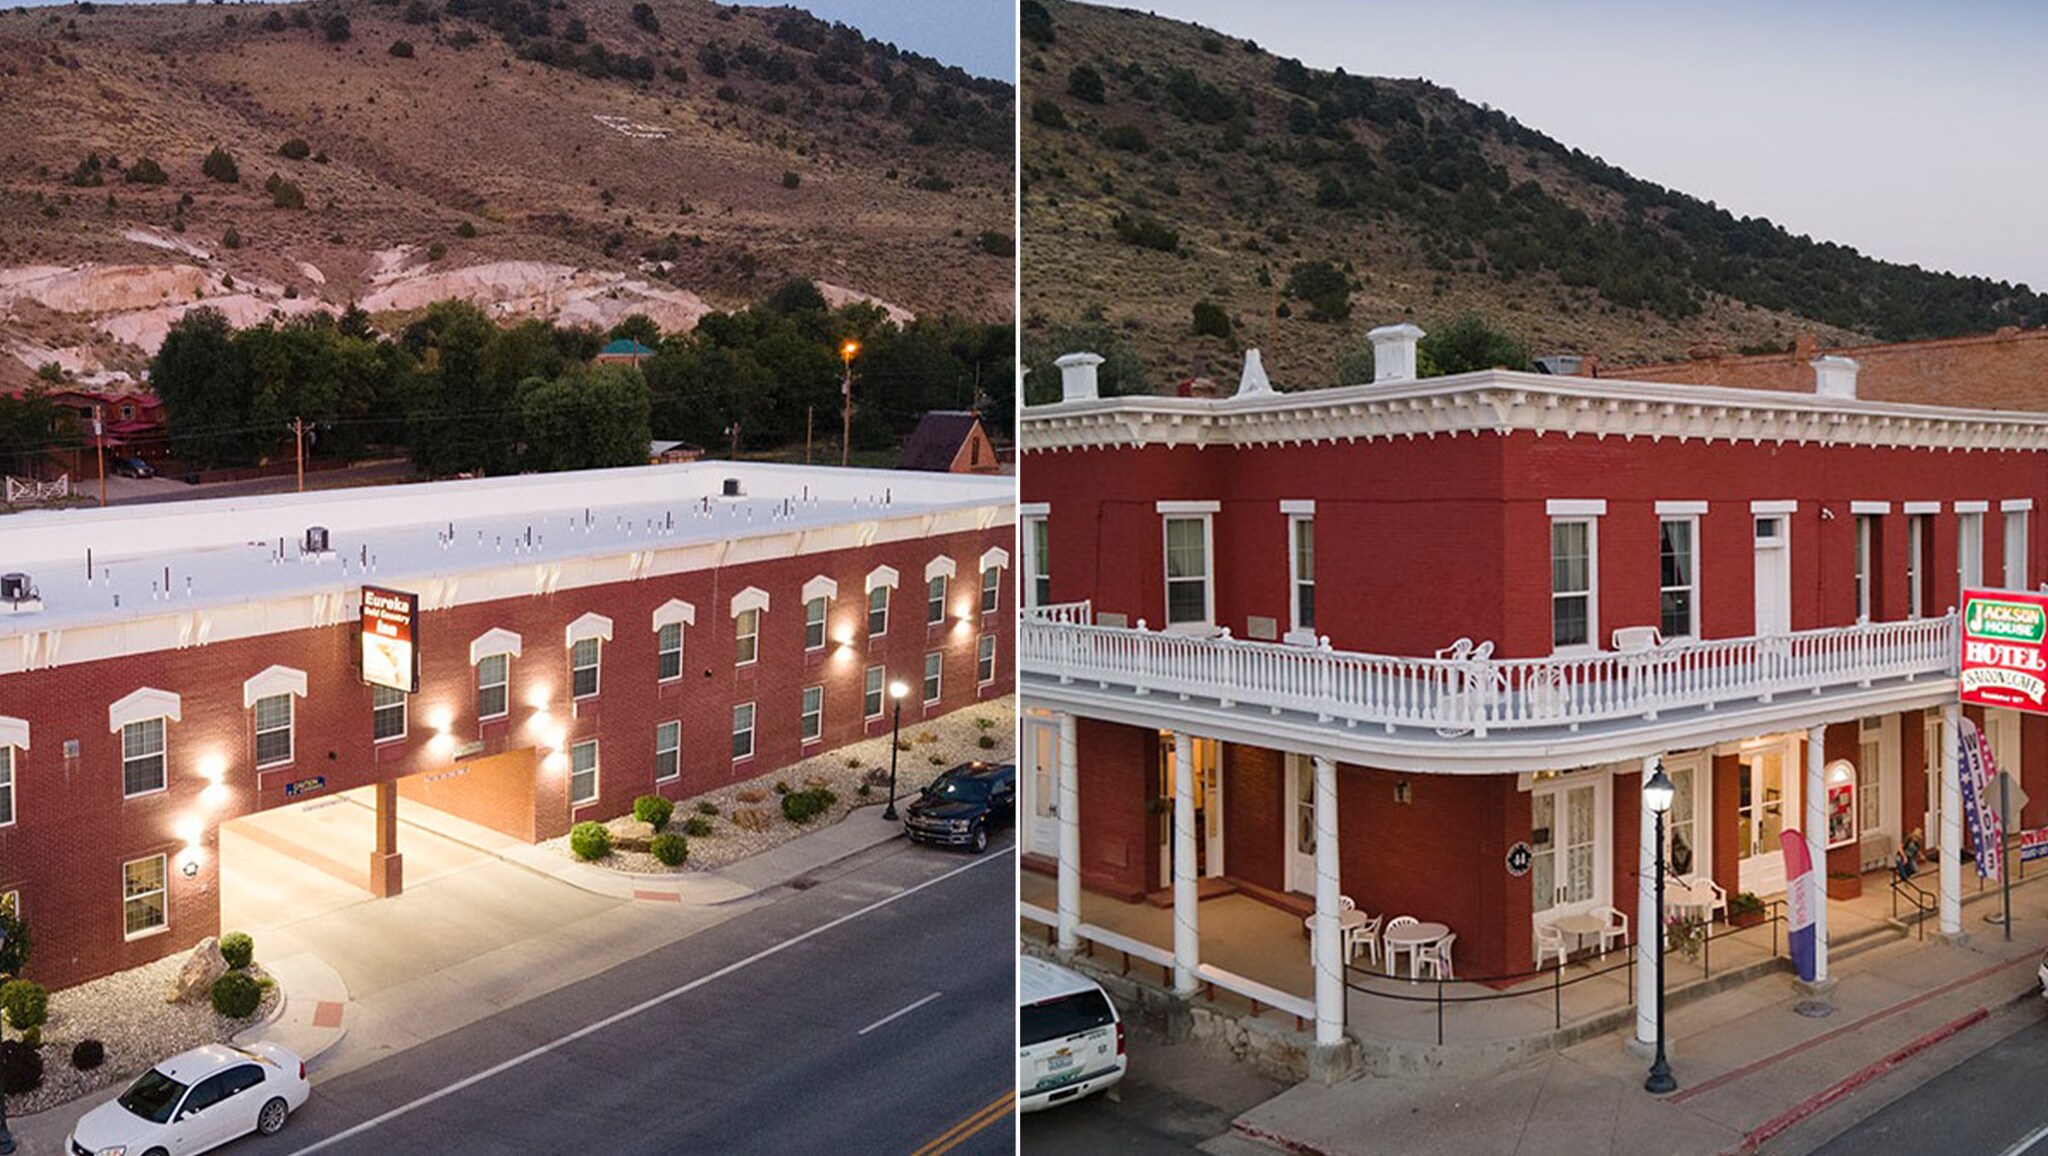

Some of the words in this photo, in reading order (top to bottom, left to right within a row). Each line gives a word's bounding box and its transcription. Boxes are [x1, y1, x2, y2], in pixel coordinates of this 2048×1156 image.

[365, 591, 410, 613] Eureka
[377, 619, 397, 637] Inn
[1970, 602, 2040, 632] JACKSON
[1985, 619, 2035, 637] HOUSE
[1966, 641, 2047, 672] HOTEL
